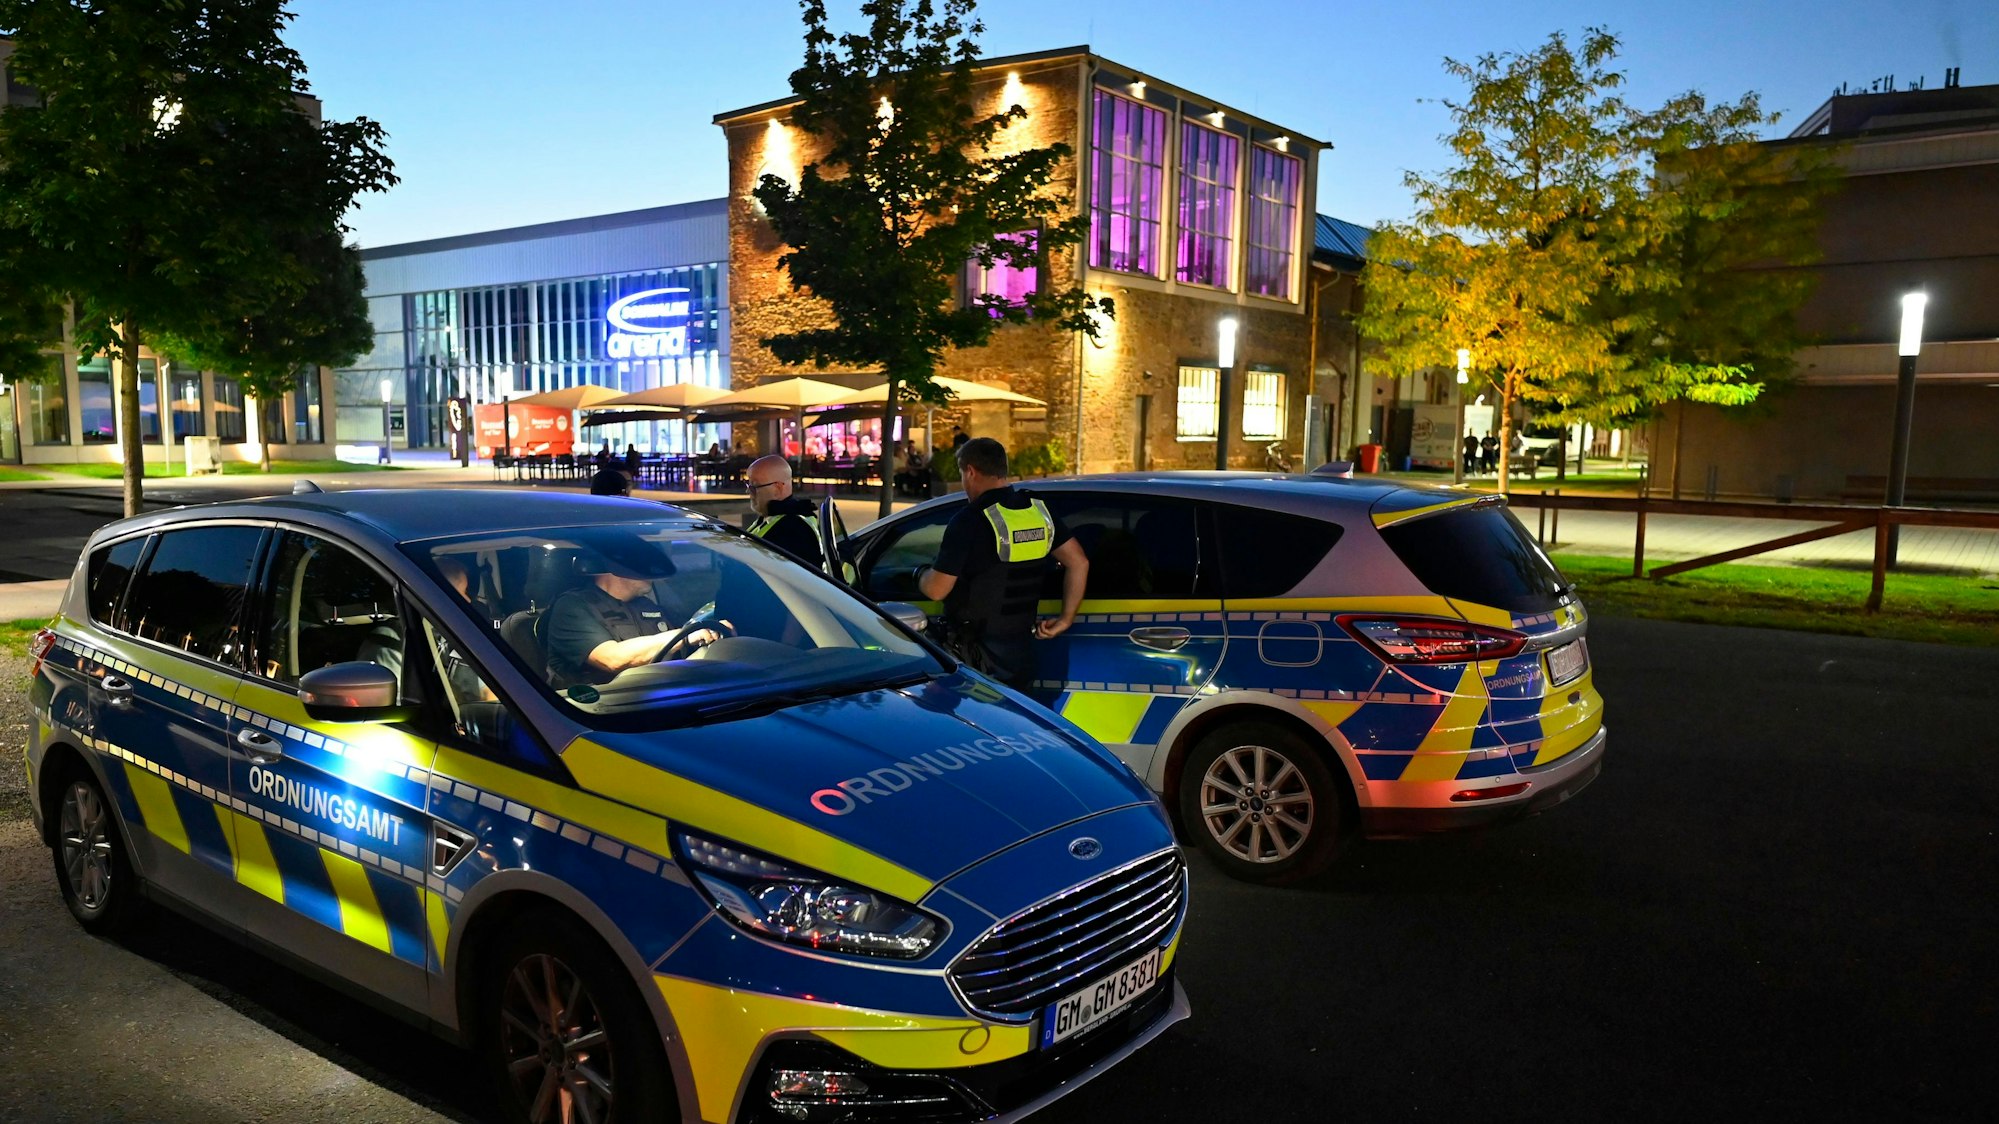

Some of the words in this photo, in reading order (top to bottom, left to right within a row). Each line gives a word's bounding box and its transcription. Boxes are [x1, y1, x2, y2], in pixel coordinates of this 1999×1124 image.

[608, 327, 686, 358] arena
[249, 766, 405, 846] ORDNUNGSAMT
[1056, 996, 1081, 1034] GM
[1094, 977, 1117, 1015] GM
[1118, 954, 1156, 1001] 8381
[1045, 1031, 1051, 1040] D
